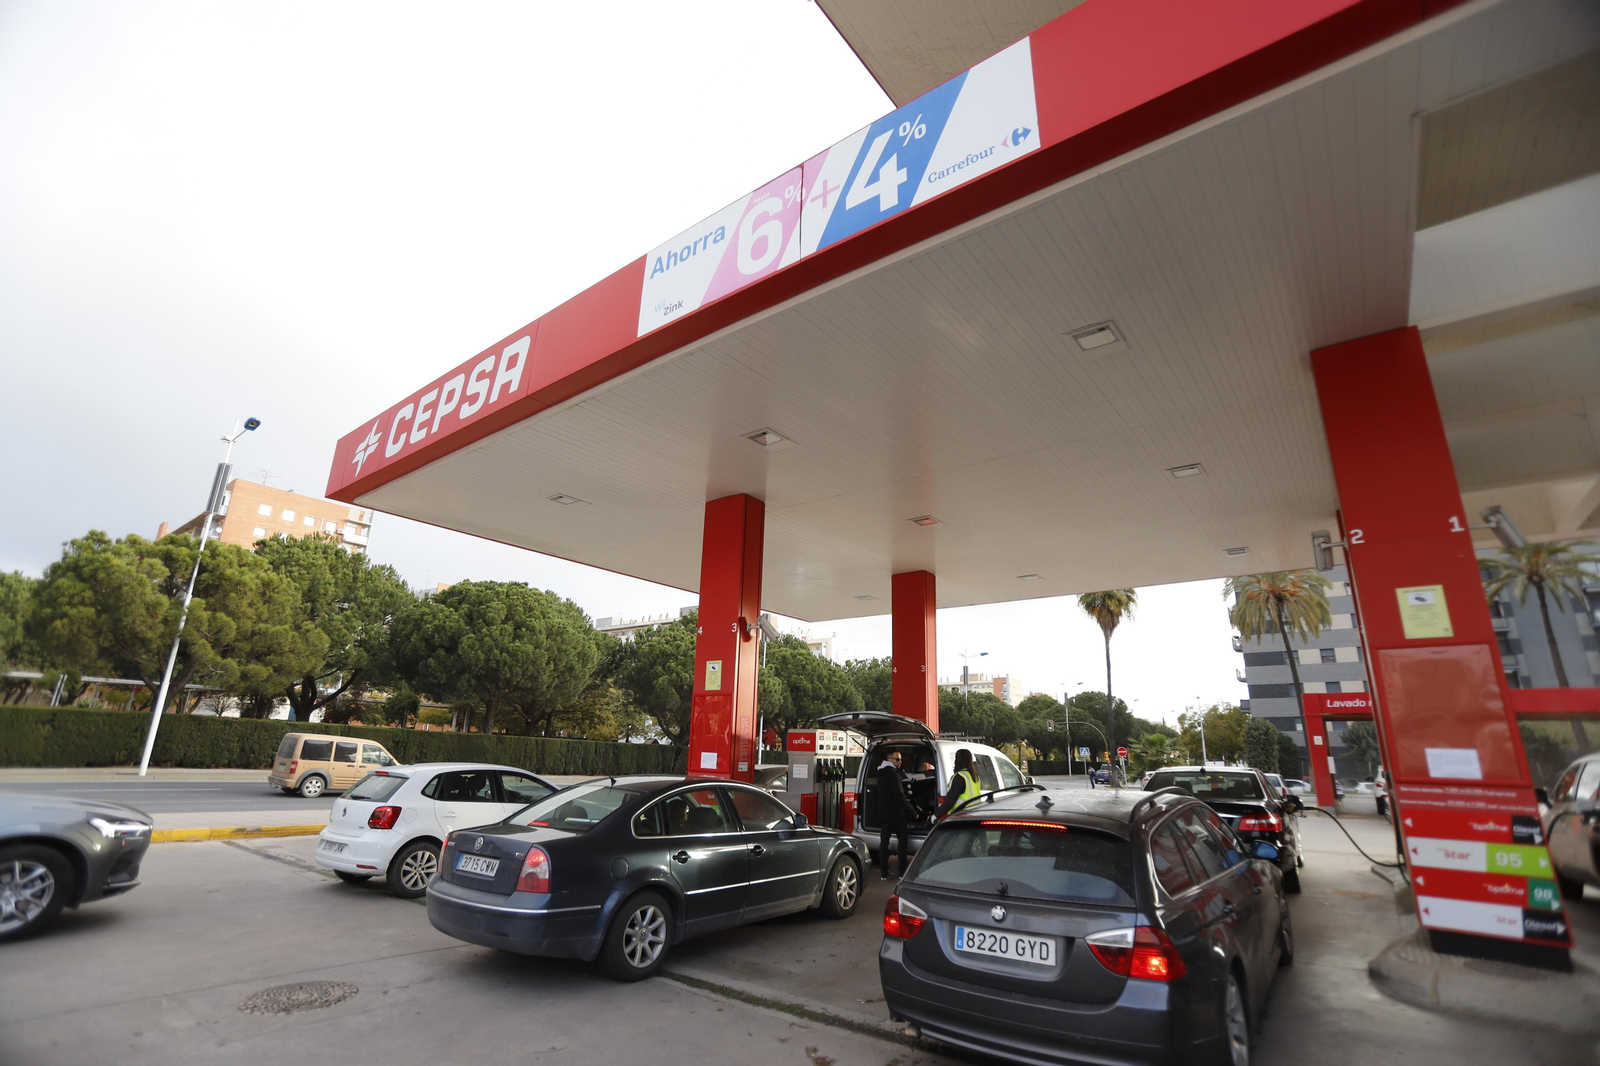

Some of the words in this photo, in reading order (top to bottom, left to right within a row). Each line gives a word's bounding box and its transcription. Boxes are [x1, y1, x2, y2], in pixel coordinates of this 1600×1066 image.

[928, 145, 996, 184] Carrefour
[650, 225, 726, 280] Ahorra
[384, 335, 531, 459] CEPSA
[1448, 516, 1465, 532] 1
[1350, 529, 1365, 545] 2
[697, 626, 703, 636] 4
[731, 622, 738, 632] 3
[892, 666, 898, 674] 4
[920, 664, 926, 673] 3
[1326, 698, 1367, 708] Lavado
[792, 737, 811, 745] optima
[1512, 825, 1541, 835] Diesel
[1444, 850, 1471, 861] star
[1495, 851, 1523, 868] 95
[461, 856, 481, 871] 3715
[1533, 887, 1553, 900] 98
[1524, 919, 1557, 932] Diesel
[966, 931, 1009, 955] 8220
[1015, 938, 1050, 961] GYD
